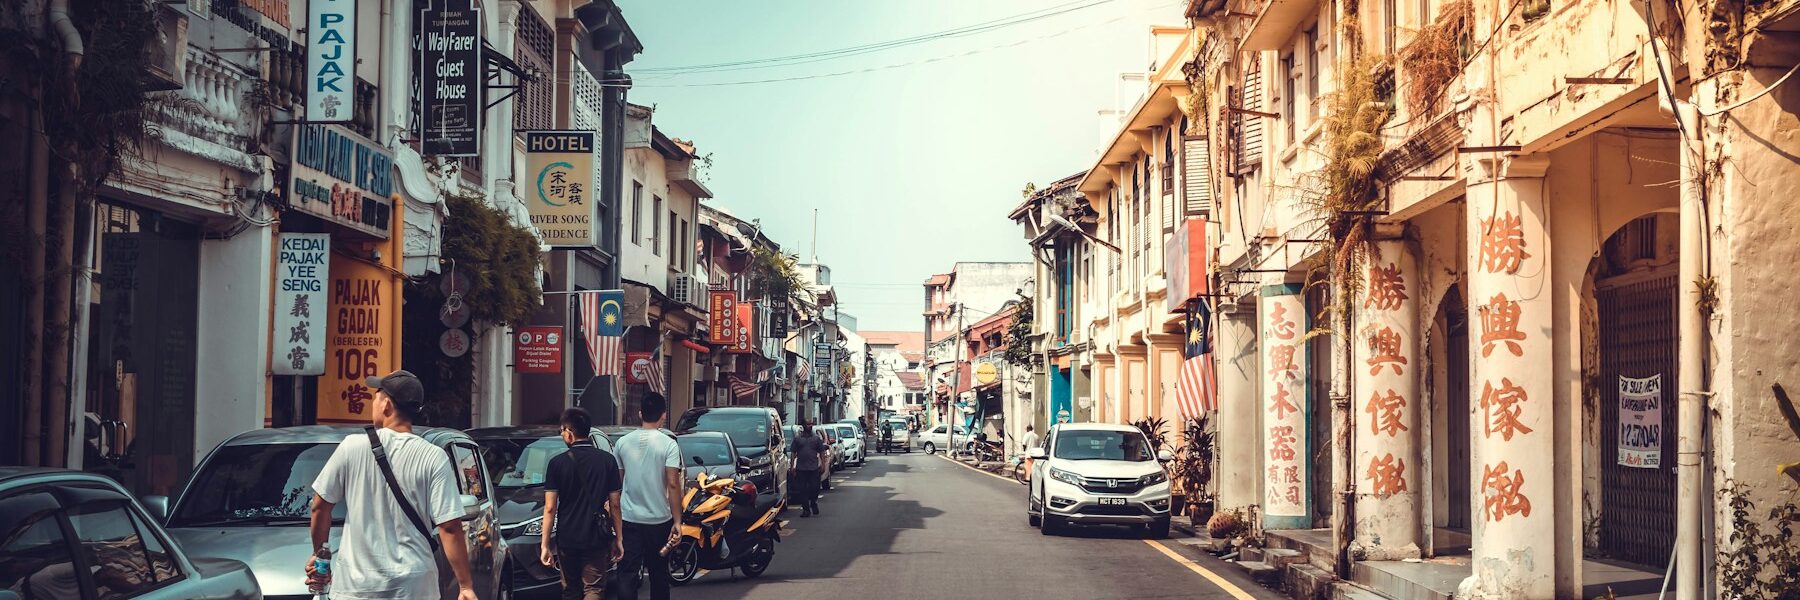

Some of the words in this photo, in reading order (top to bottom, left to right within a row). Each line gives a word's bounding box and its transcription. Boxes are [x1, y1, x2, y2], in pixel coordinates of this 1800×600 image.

[428, 31, 474, 54] WayFarer
[317, 13, 346, 92] PAJAK
[436, 58, 464, 78] Guest
[436, 80, 466, 100] House
[532, 136, 589, 151] HOTEL
[530, 214, 558, 224] RIVER
[560, 214, 588, 224] SONG
[542, 230, 588, 238] SIDENCE
[282, 238, 324, 250] KEDAI
[280, 252, 324, 264] PAJAK
[288, 266, 316, 278] YEE
[282, 279, 321, 292] SENG
[335, 279, 381, 306] PAJAK
[338, 308, 379, 335] GADAI
[333, 336, 382, 346] (BERLESEN)
[536, 334, 542, 342] P
[335, 348, 378, 381] 106
